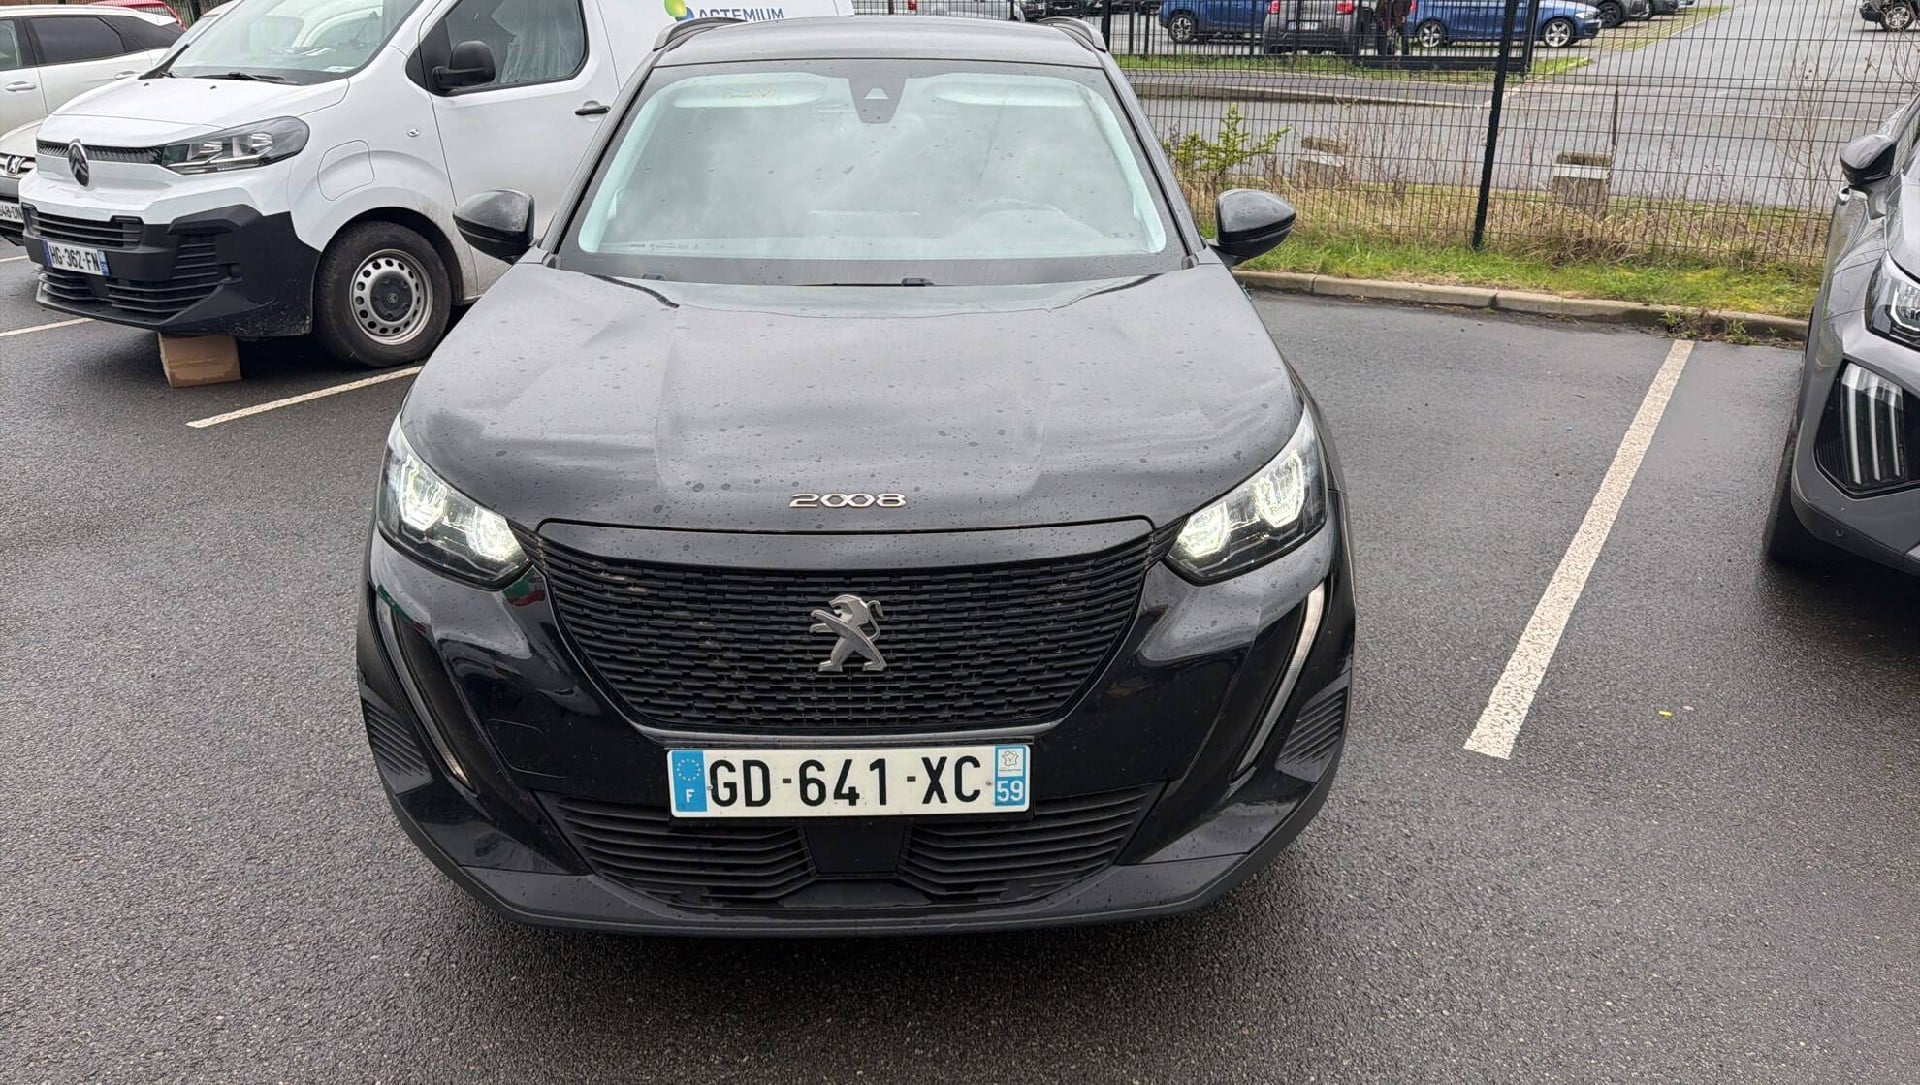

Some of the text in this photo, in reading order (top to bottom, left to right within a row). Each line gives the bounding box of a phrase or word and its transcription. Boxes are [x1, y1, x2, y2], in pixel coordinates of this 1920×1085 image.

[699, 8, 784, 21] ACTEMIUM
[49, 244, 101, 271] HG-362-FN
[789, 493, 907, 508] 2008
[709, 755, 981, 807] GD-641-XC
[685, 788, 695, 803] F
[997, 780, 1023, 802] 59
